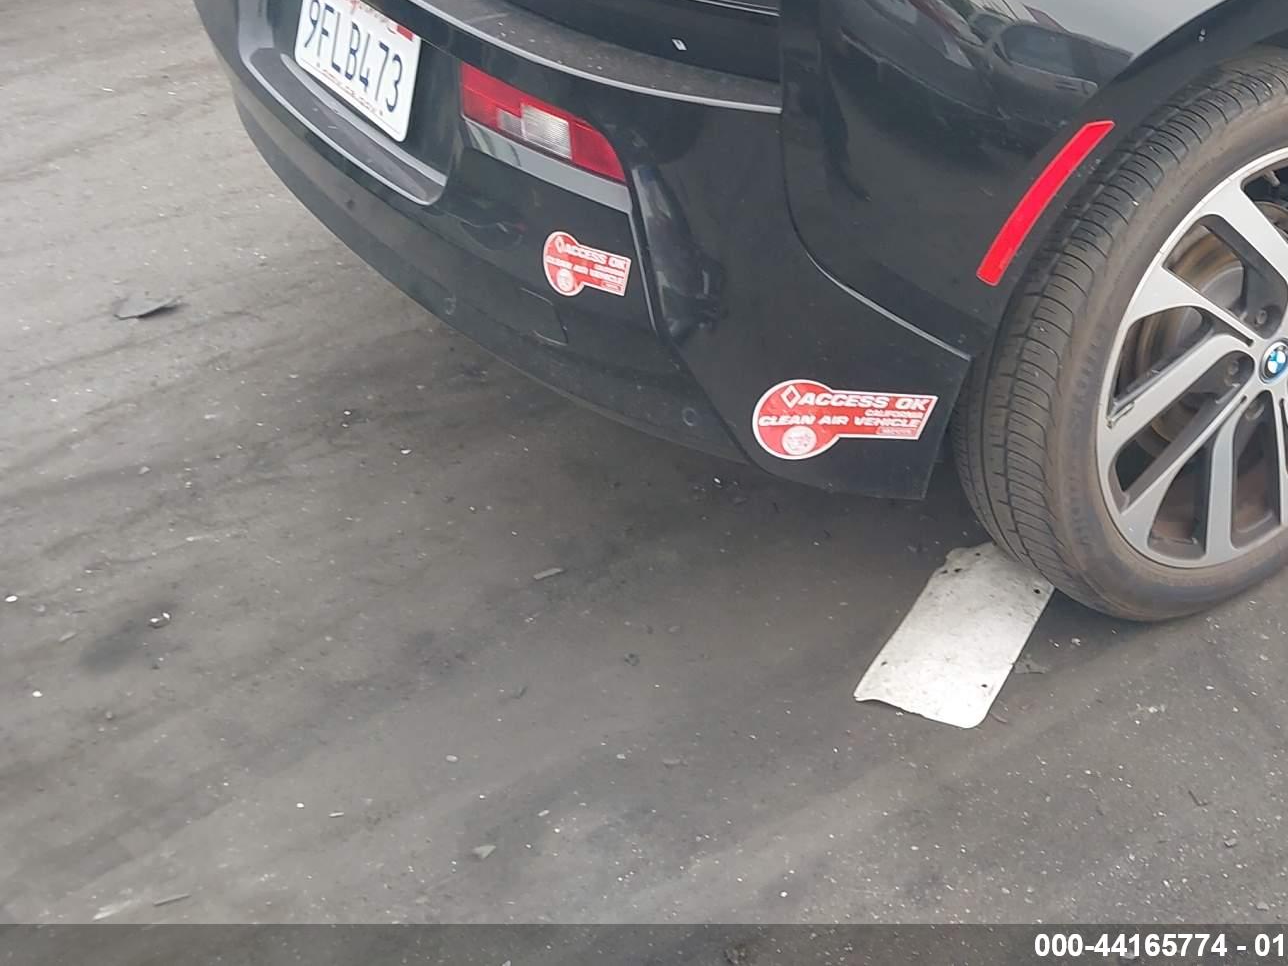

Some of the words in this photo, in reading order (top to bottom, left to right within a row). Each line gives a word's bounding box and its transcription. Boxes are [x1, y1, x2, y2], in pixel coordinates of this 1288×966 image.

[798, 392, 889, 409] ACCESS
[895, 397, 931, 411] OK
[758, 415, 816, 427] CLEAN
[818, 415, 849, 426] AIR
[854, 417, 922, 428] VEHICLE
